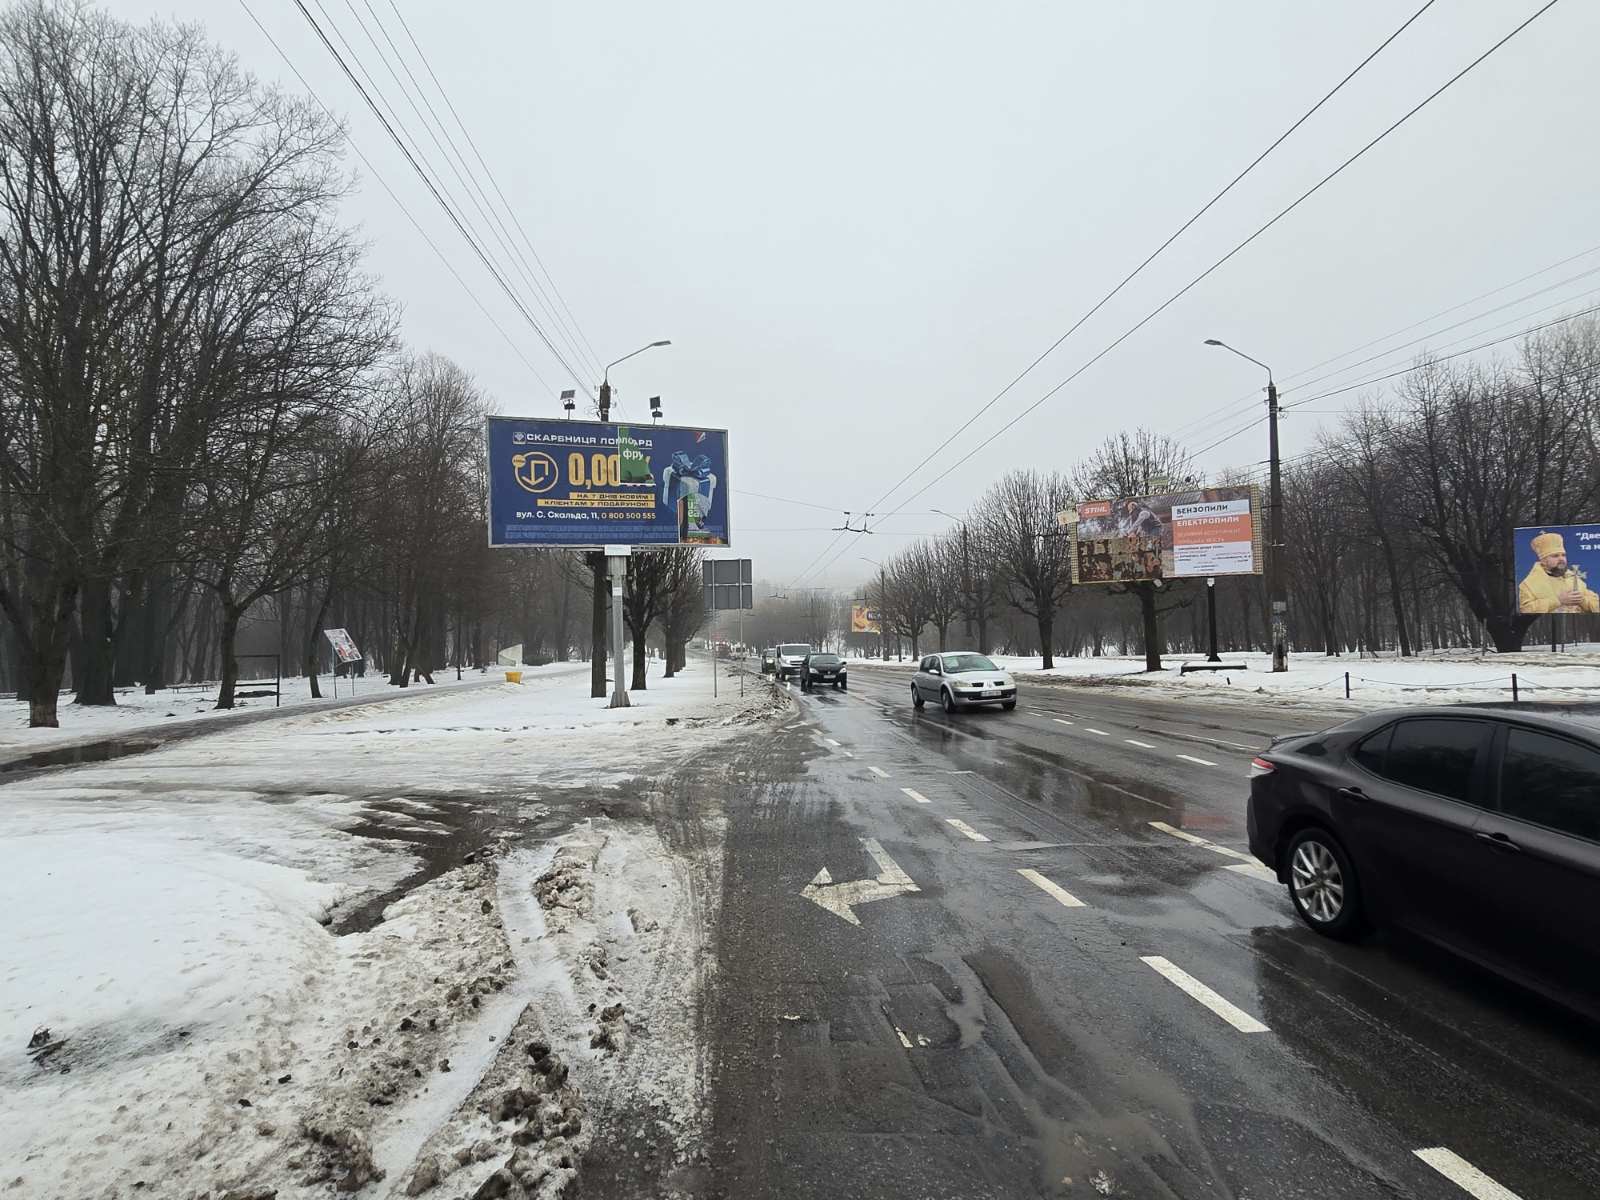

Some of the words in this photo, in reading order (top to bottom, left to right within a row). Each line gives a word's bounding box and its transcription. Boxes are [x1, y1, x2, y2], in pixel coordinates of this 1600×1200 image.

[526, 433, 597, 444] СКАРБНИЦЯ
[1176, 504, 1228, 515] БЕНЗОПИЛИ
[516, 511, 533, 520] вул.
[1177, 516, 1240, 527] ЕЛЕКТРОПИЛИ
